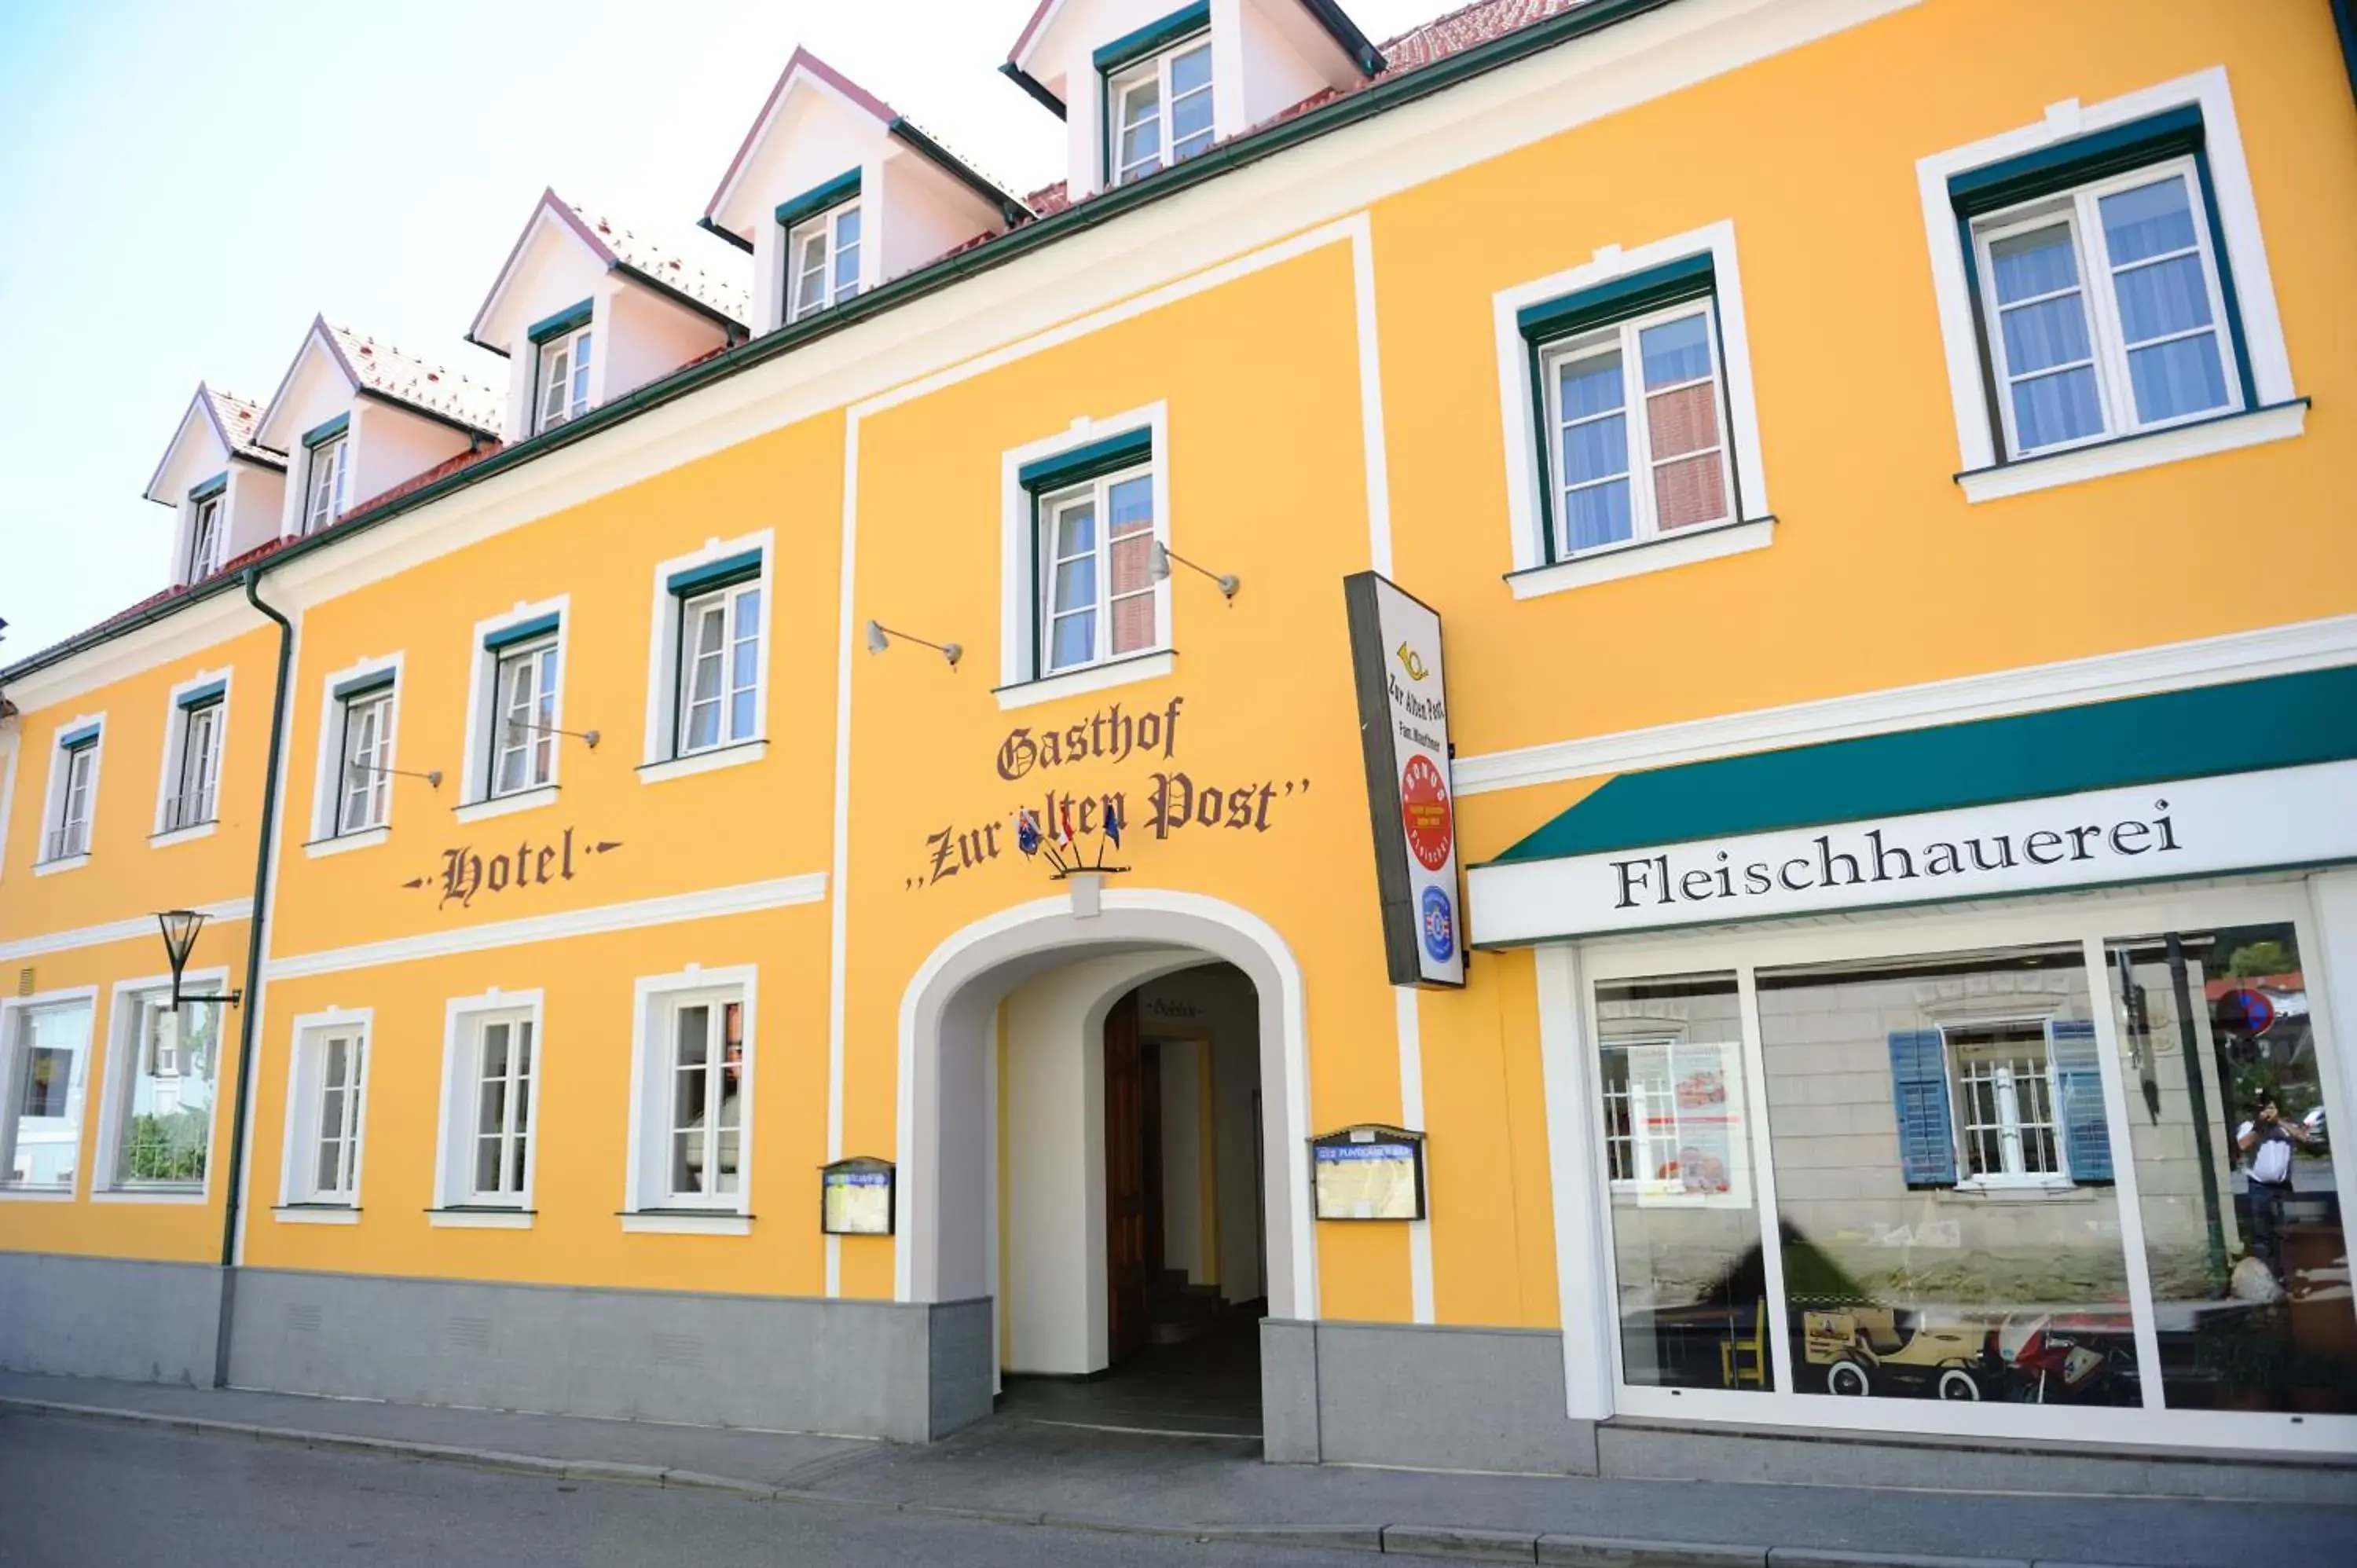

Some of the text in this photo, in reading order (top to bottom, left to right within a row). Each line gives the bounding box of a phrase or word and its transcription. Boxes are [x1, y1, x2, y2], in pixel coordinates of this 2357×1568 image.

[997, 696, 1184, 782] Gasthof
[1010, 788, 1130, 859] lten
[1609, 798, 2183, 909] Fleischhauerei
[438, 826, 576, 911] Hotel
